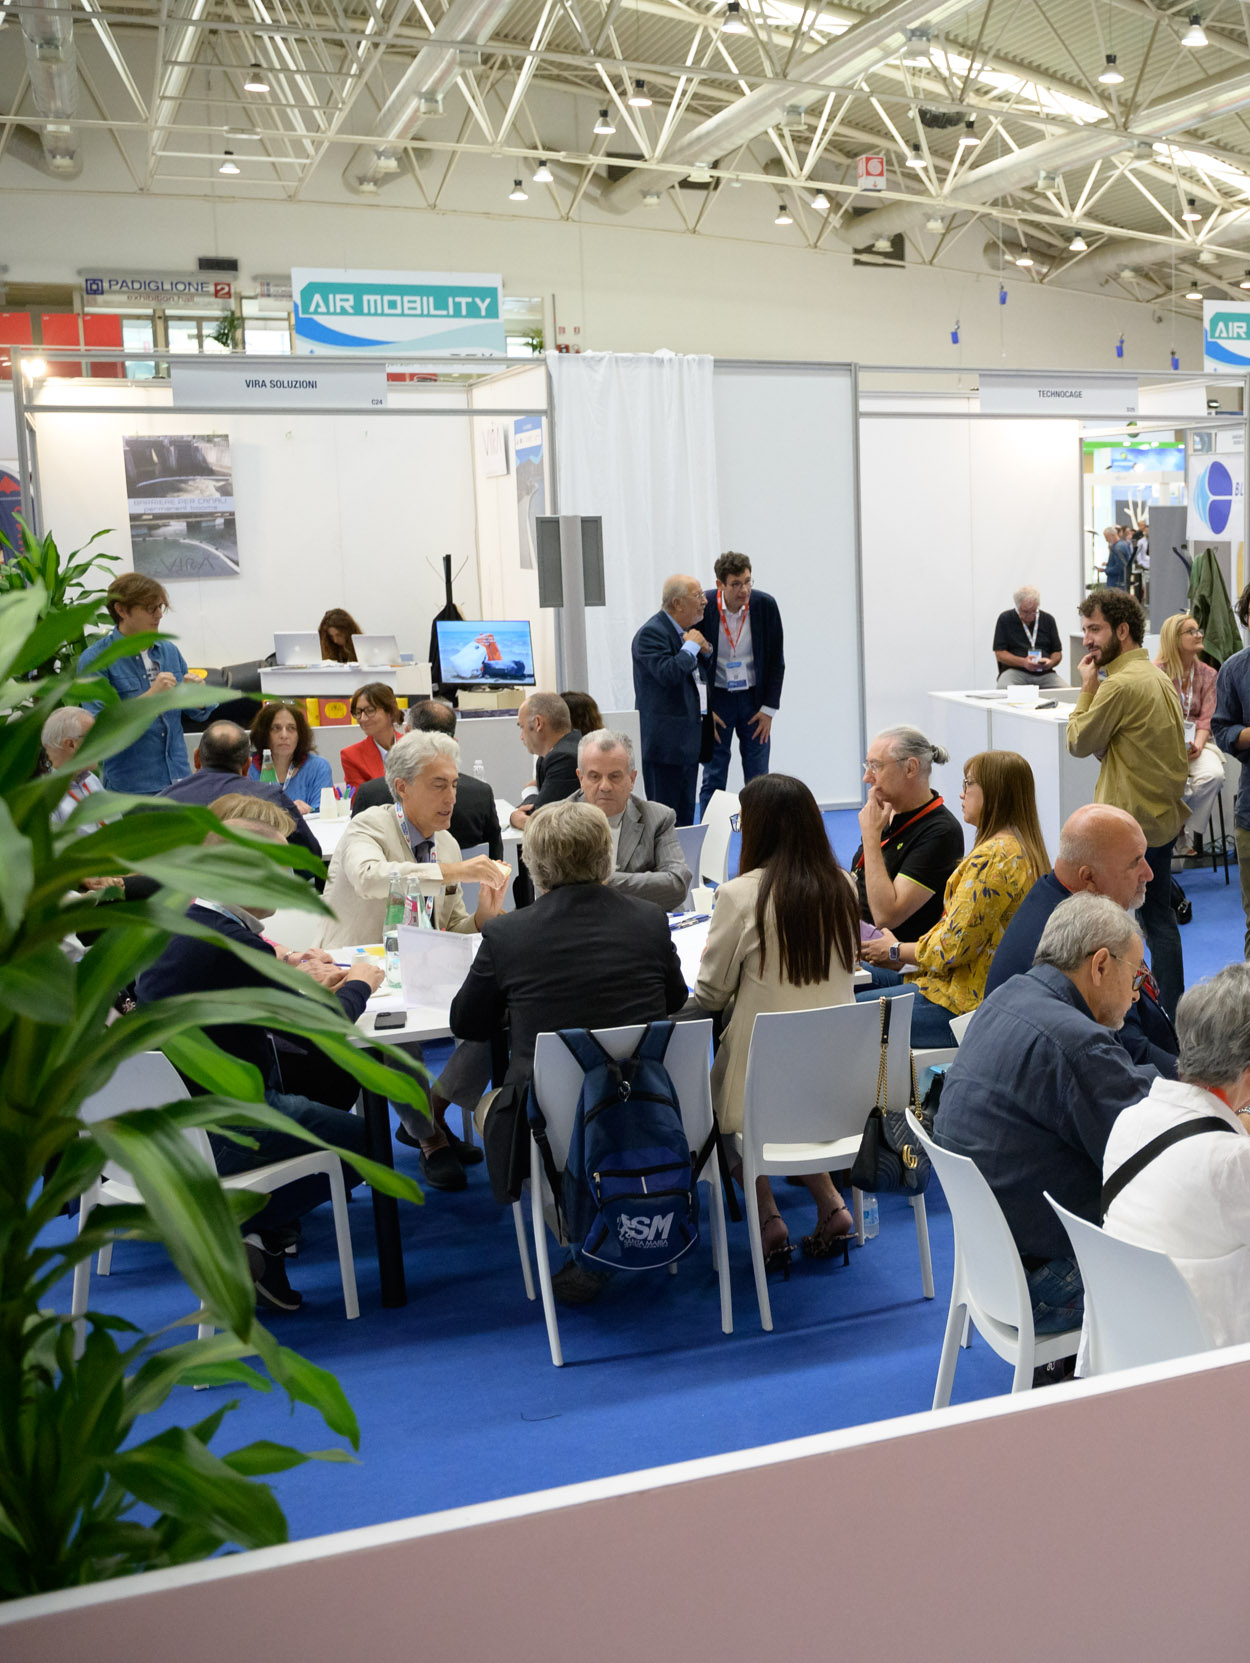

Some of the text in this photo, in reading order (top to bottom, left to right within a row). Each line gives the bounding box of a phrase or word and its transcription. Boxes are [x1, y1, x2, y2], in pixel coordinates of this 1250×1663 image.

[108, 279, 230, 298] PADIGLIONE 2
[126, 294, 195, 303] exhibition hall
[308, 293, 492, 316] AIR MOBILITY
[1214, 321, 1247, 338] AIR
[244, 379, 318, 389] VIRA SOLUZIONI
[1038, 390, 1083, 399] TECHNOCAGE
[133, 498, 176, 506] BARRIERE
[143, 505, 188, 513] permanent
